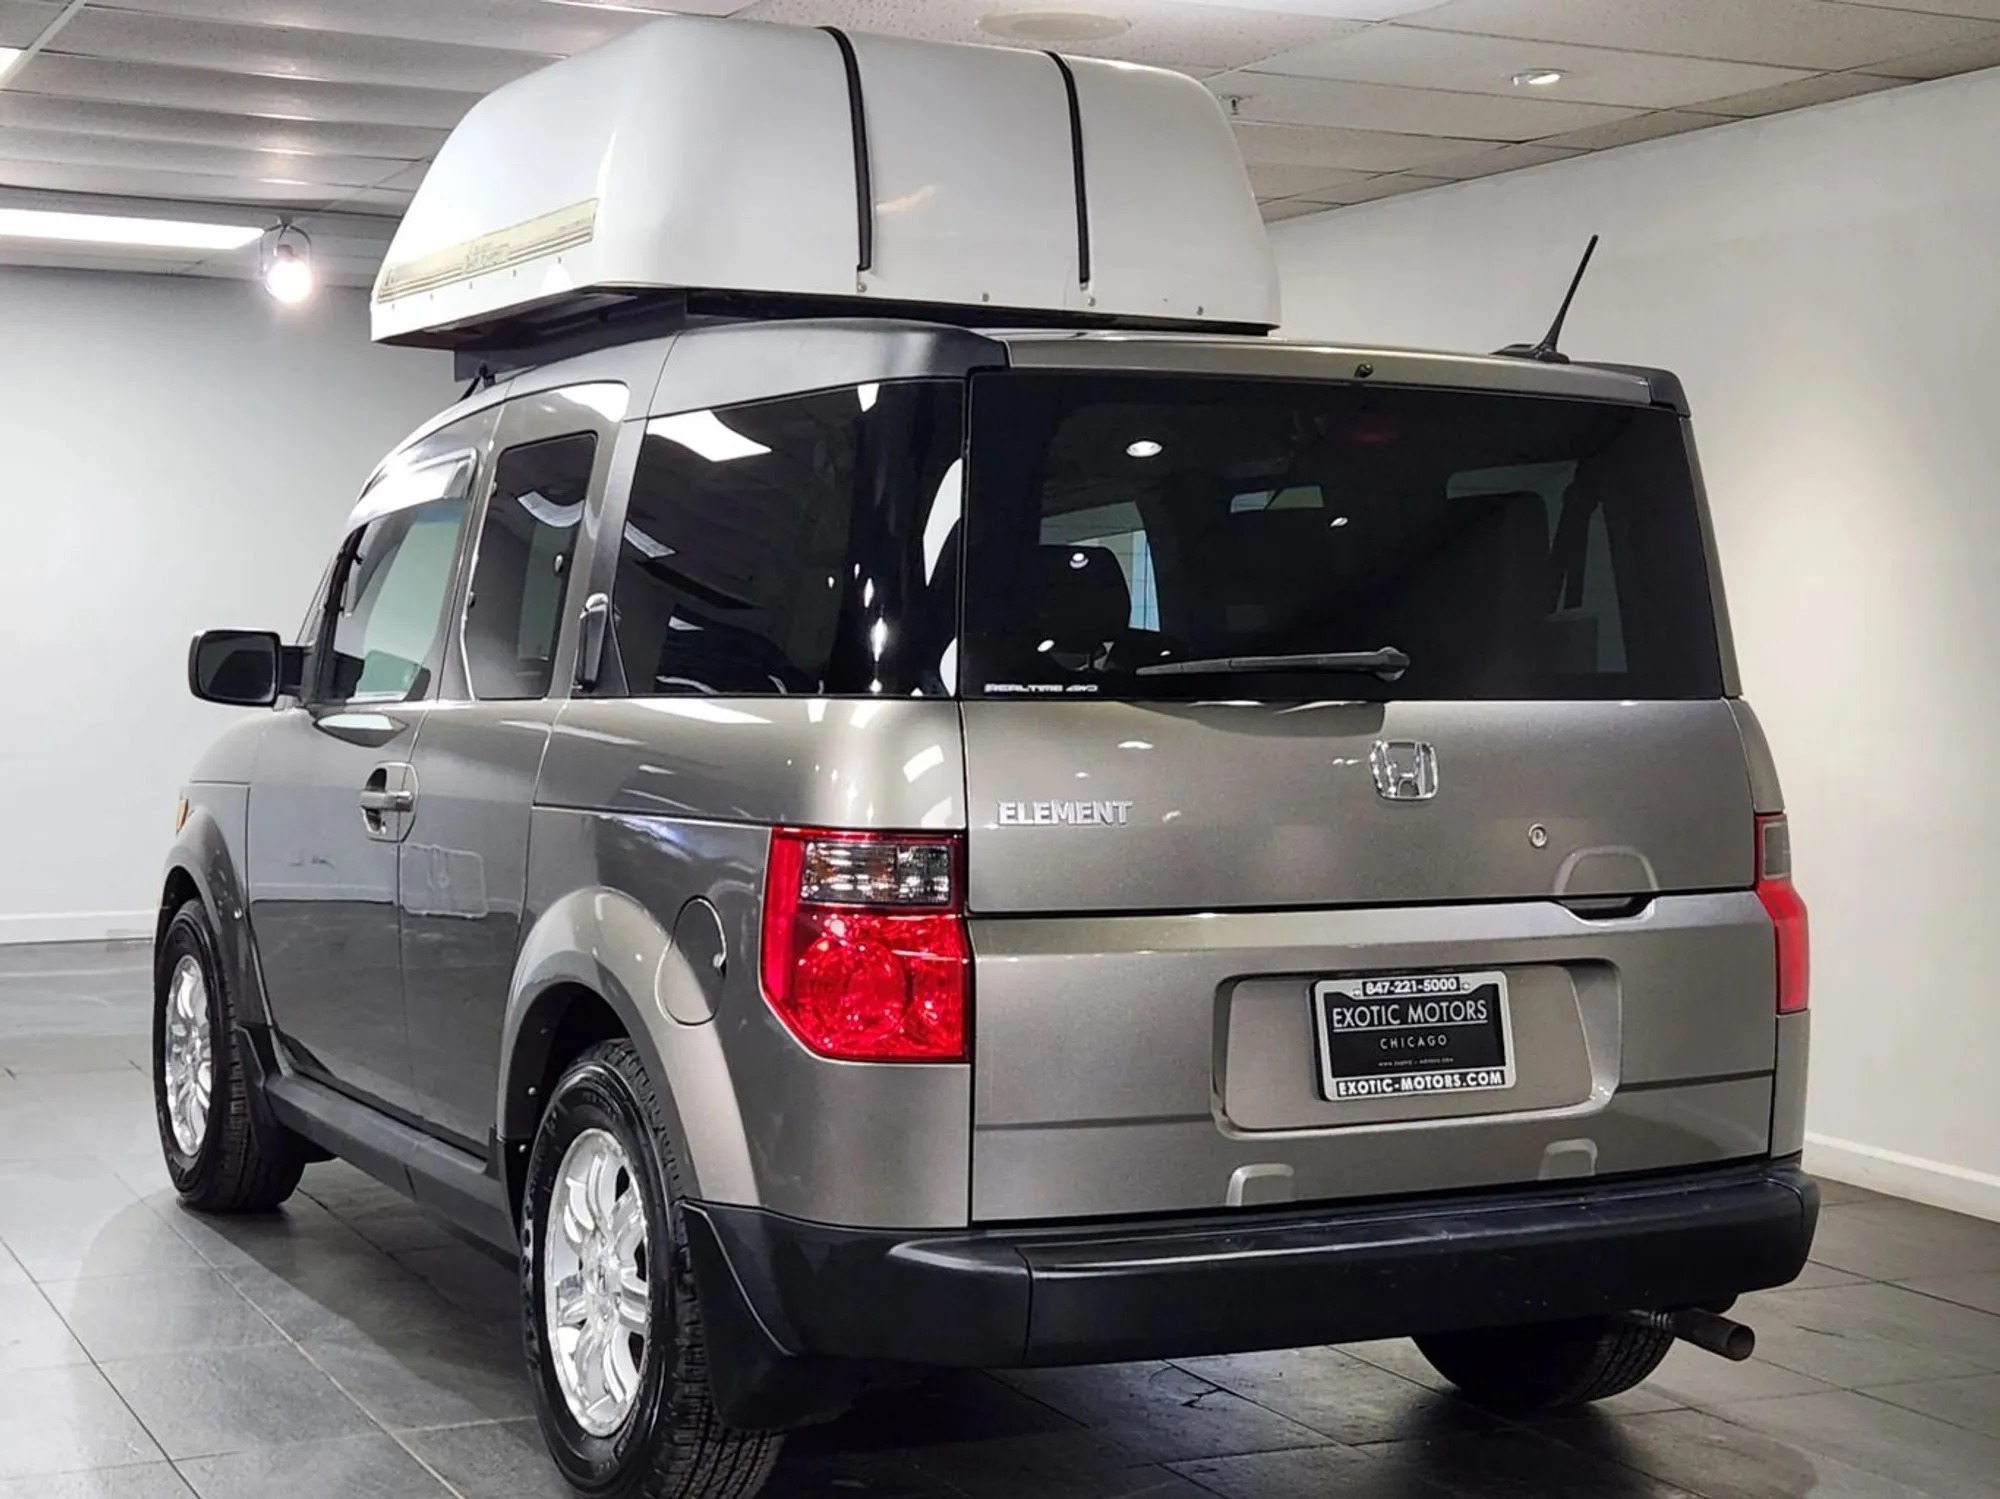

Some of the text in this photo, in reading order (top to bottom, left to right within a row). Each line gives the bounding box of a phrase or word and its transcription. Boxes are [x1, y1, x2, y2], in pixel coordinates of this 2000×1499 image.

[998, 800, 1133, 826] ELEMENT
[1365, 977, 1457, 995] 847-221-5000
[1332, 1000, 1488, 1028] EXOTIC MOTORS
[1380, 1034, 1448, 1050] CHICAGO
[1338, 1071, 1503, 1096] EXOTIC-MOTORS.COM
